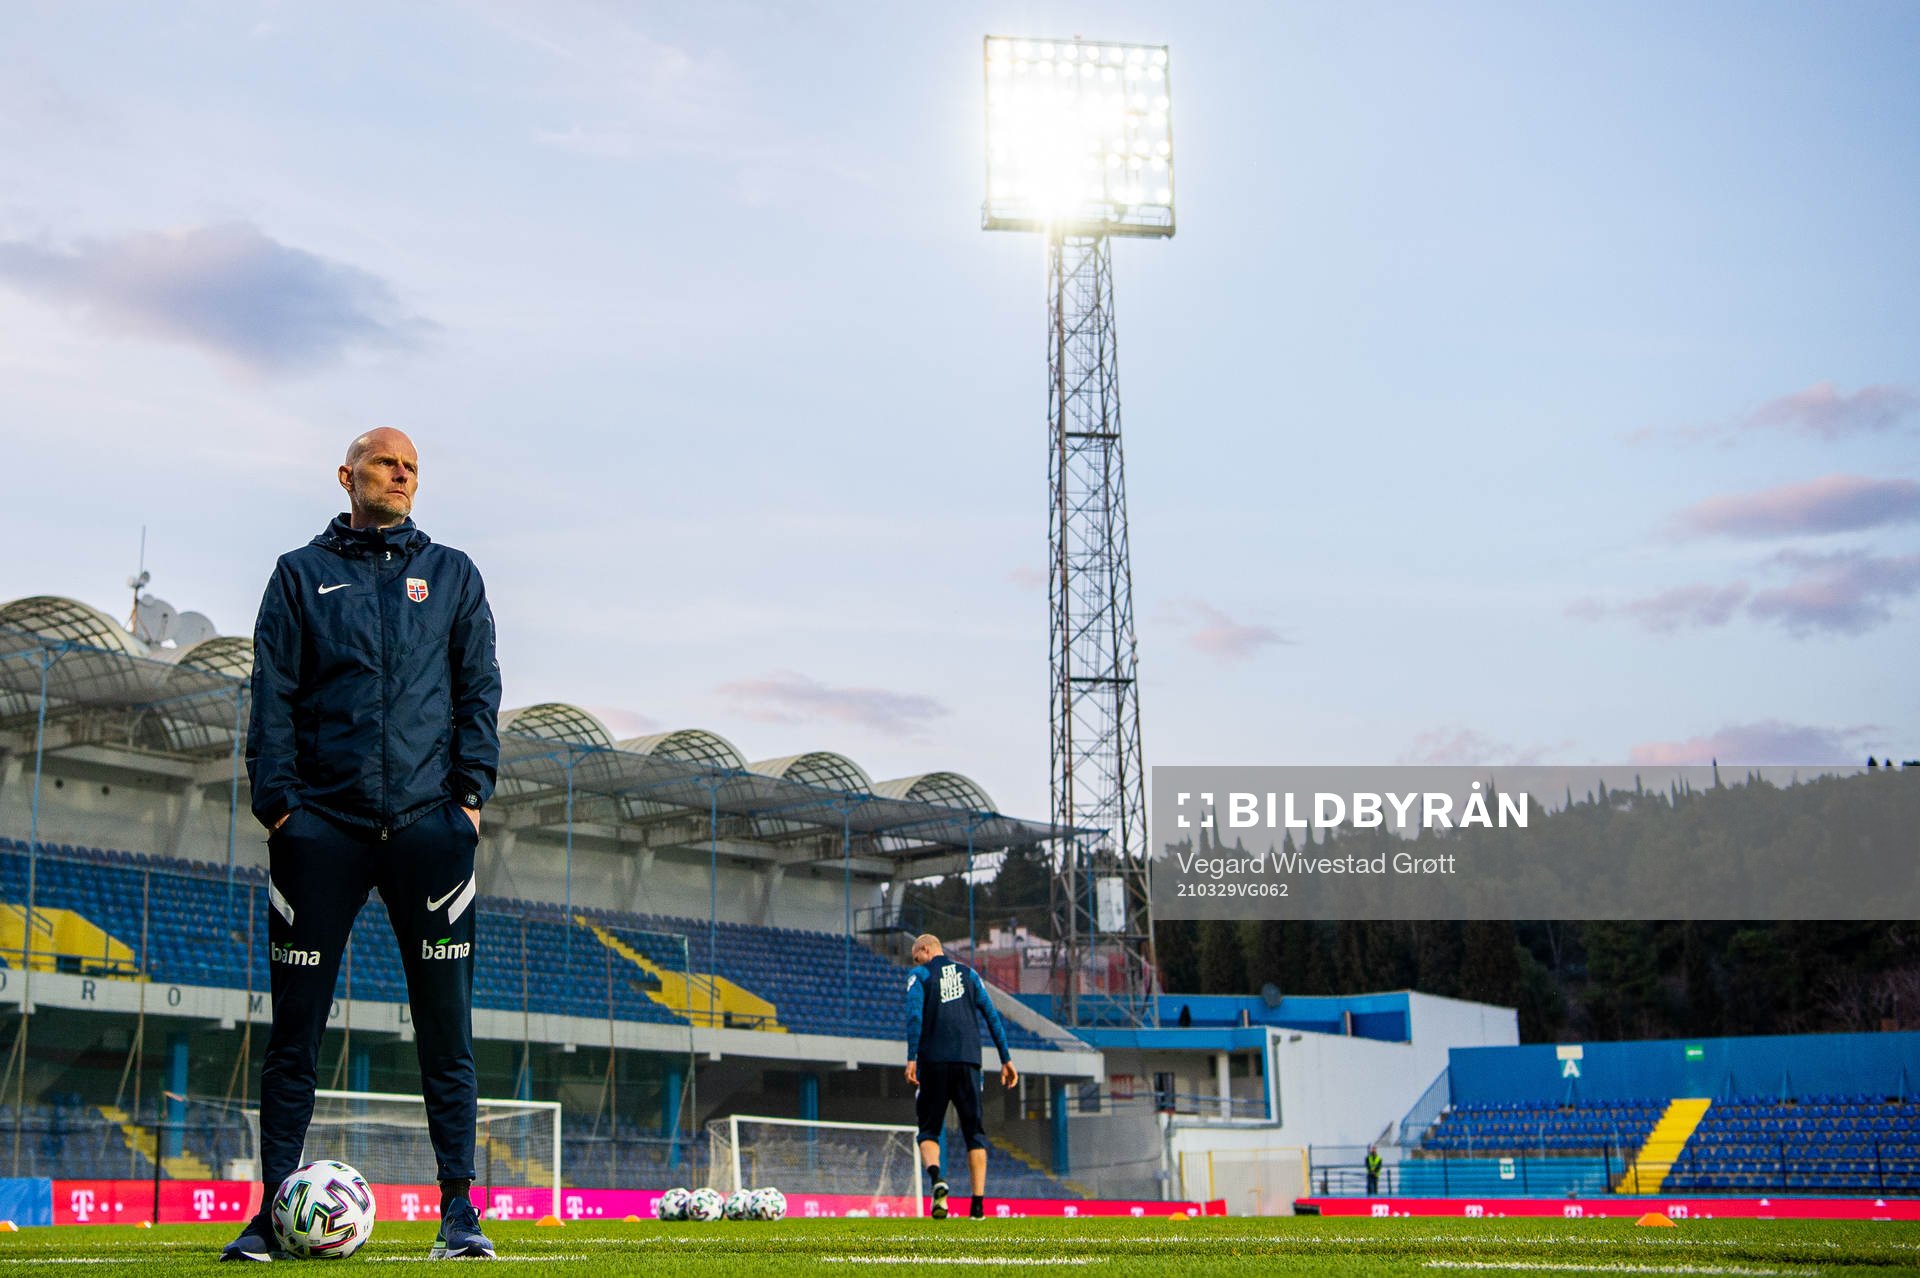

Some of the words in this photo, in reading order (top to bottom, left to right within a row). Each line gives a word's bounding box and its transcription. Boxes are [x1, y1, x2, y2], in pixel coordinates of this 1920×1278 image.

[385, 551, 391, 561] 3
[941, 964, 956, 978] EAT
[940, 972, 962, 991] MOVE
[941, 984, 965, 1003] SLEEP
[1562, 1060, 1581, 1079] A
